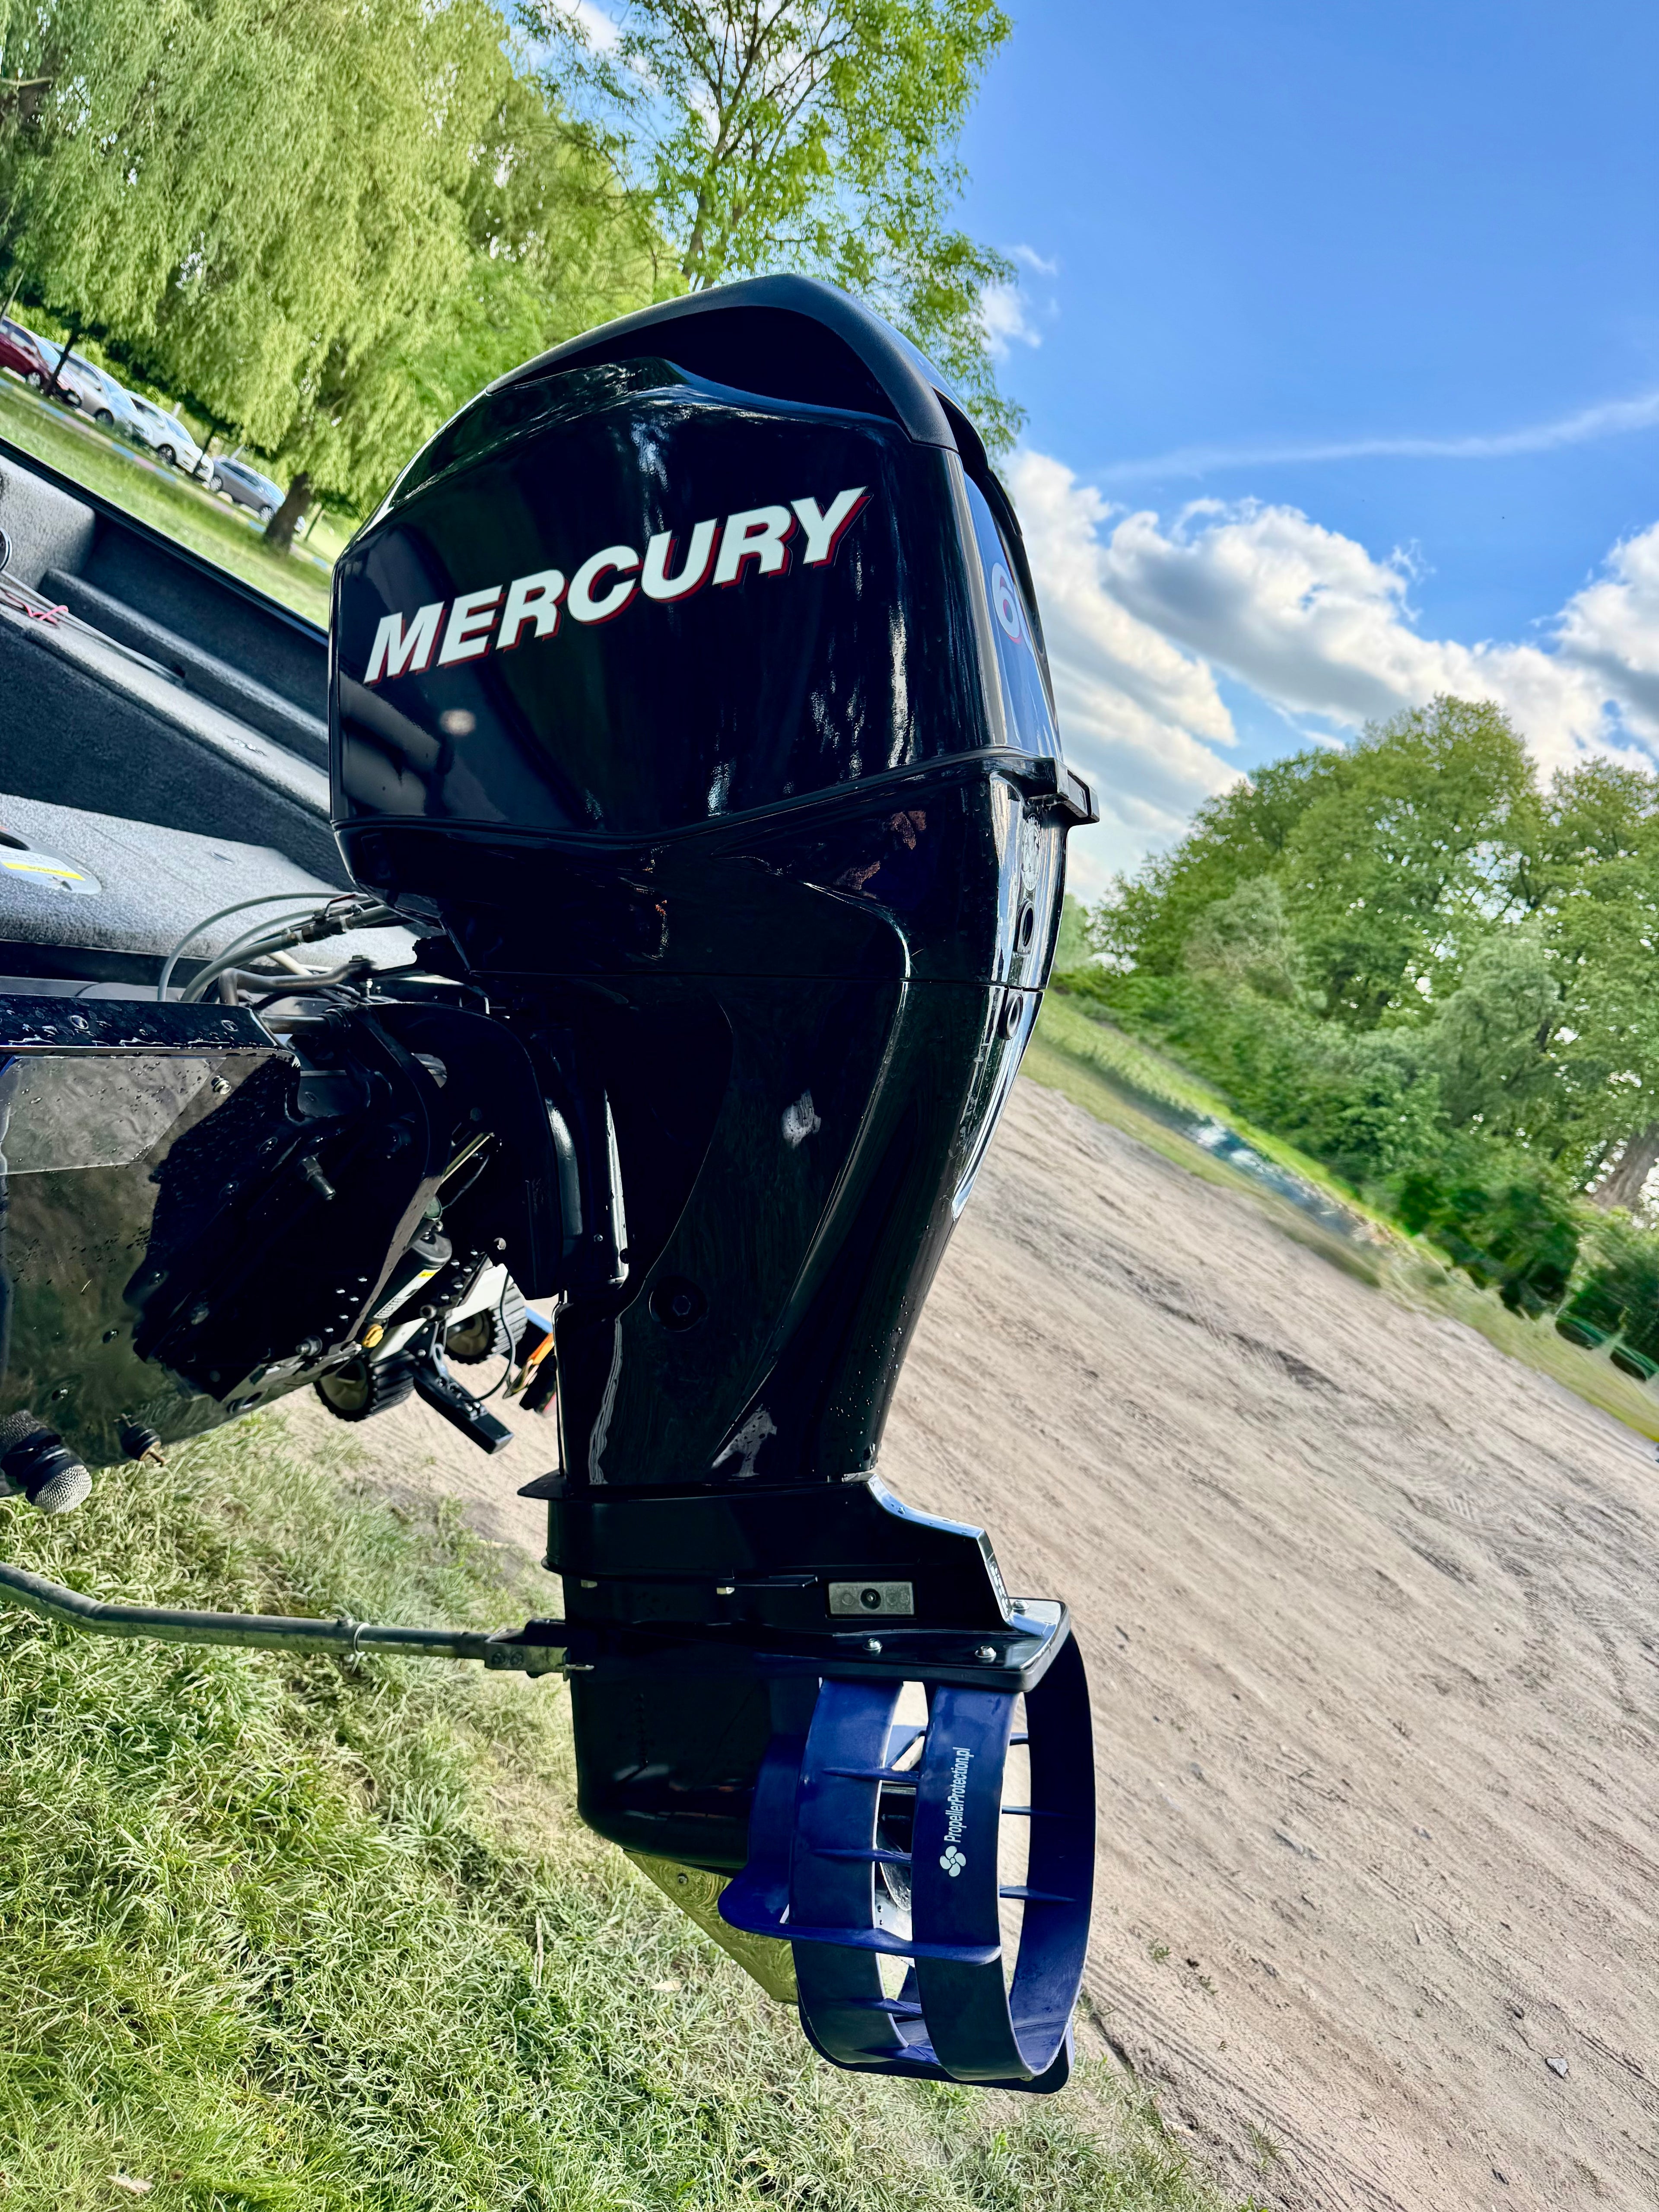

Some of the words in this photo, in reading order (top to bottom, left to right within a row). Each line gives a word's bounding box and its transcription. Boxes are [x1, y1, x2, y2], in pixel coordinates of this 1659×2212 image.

[364, 486, 870, 686] MERCURY
[992, 563, 1029, 648] 6
[944, 1747, 974, 1843] PropellerProtection.pl
